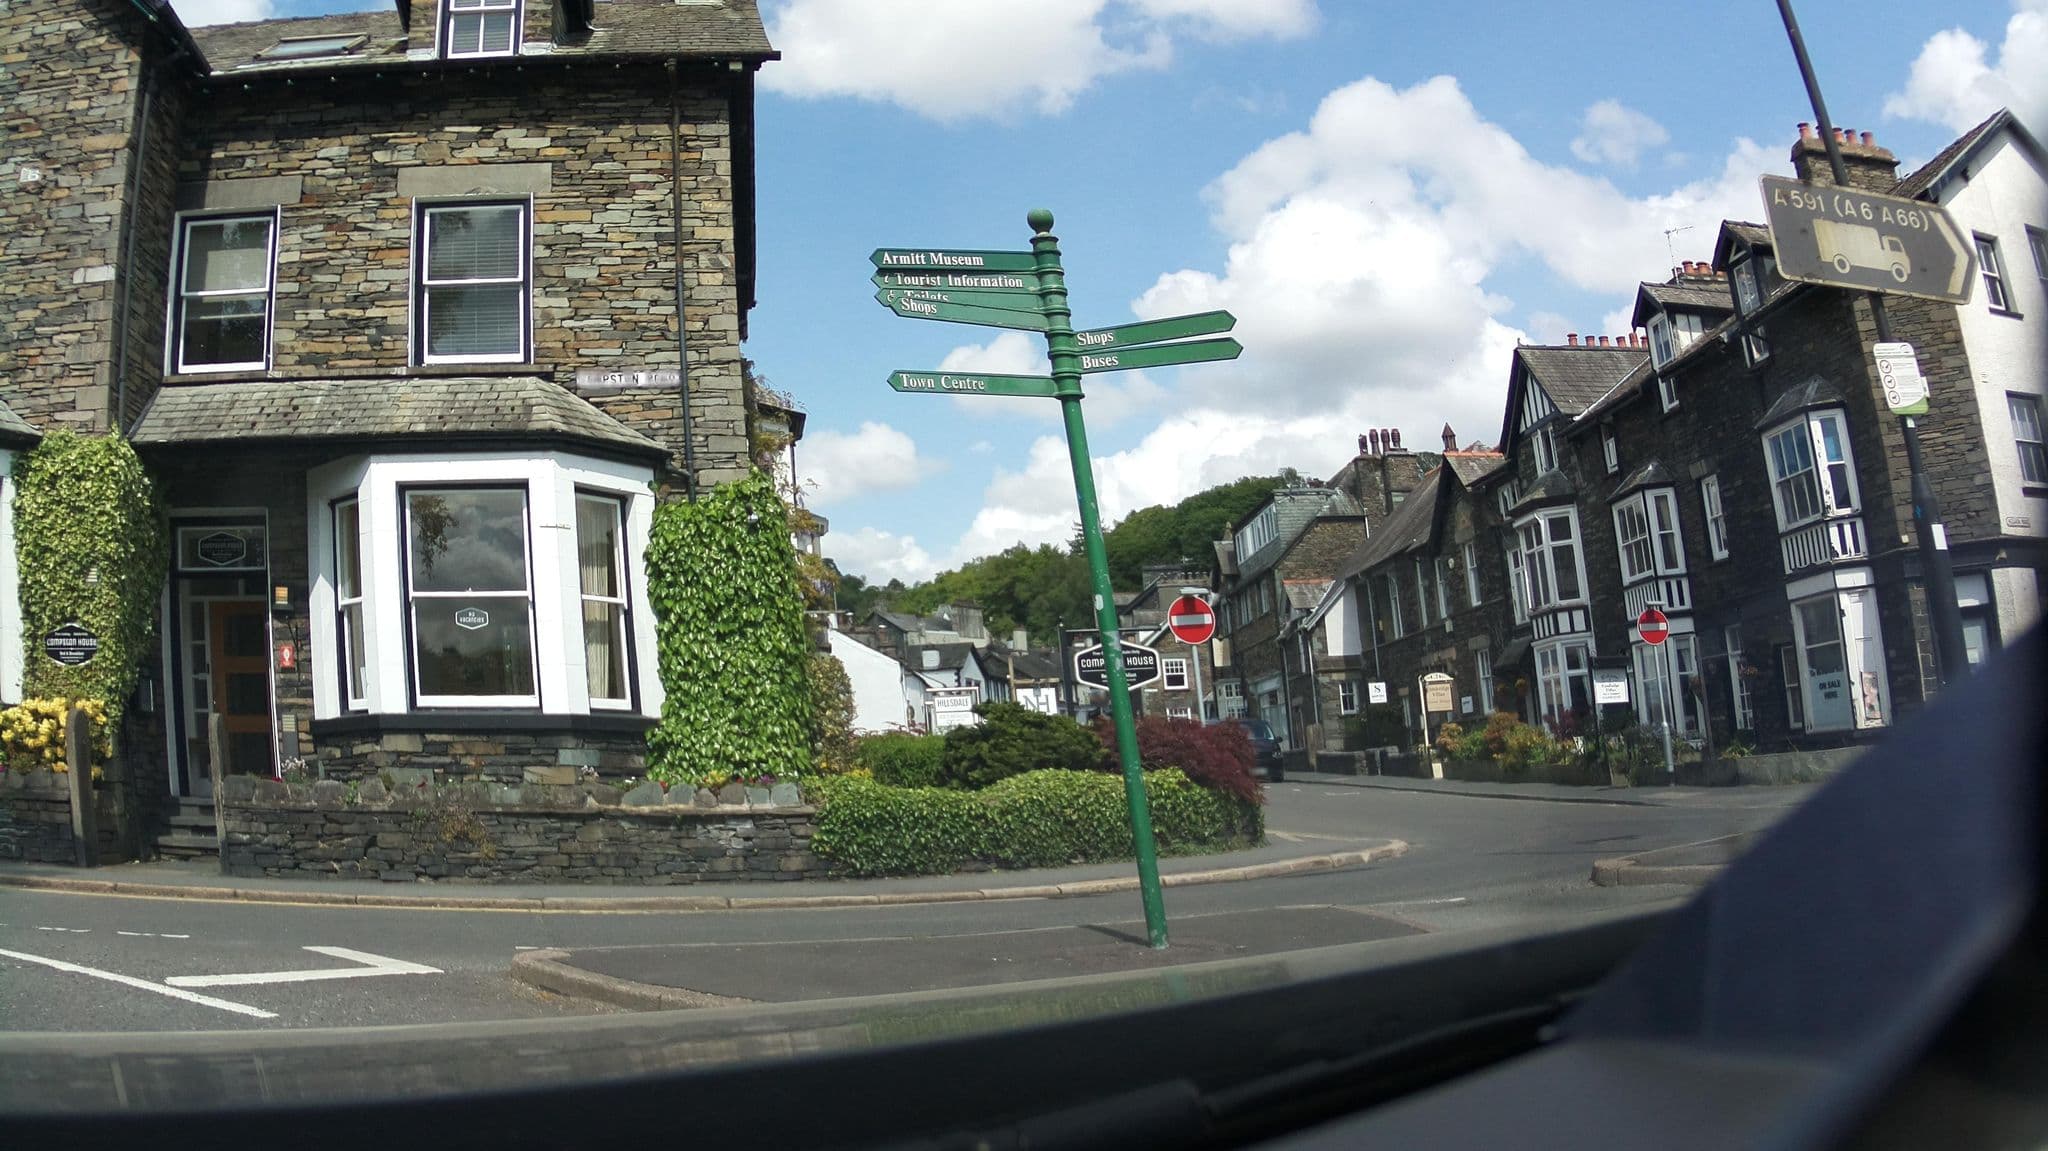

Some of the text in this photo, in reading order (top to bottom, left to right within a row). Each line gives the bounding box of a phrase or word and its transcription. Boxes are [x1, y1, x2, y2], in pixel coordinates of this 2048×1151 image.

[882, 251, 984, 266] Armitt Museum
[894, 273, 941, 286] Tourist
[948, 274, 1023, 288] Information
[901, 298, 937, 315] Shops
[1077, 331, 1114, 347] Shops
[1082, 353, 1119, 369] Buses
[900, 374, 985, 390] Town Centre
[78, 638, 97, 646] HOUSE
[1081, 656, 1154, 668] COMP HOUSE
[936, 698, 968, 707] HILLSDALE
